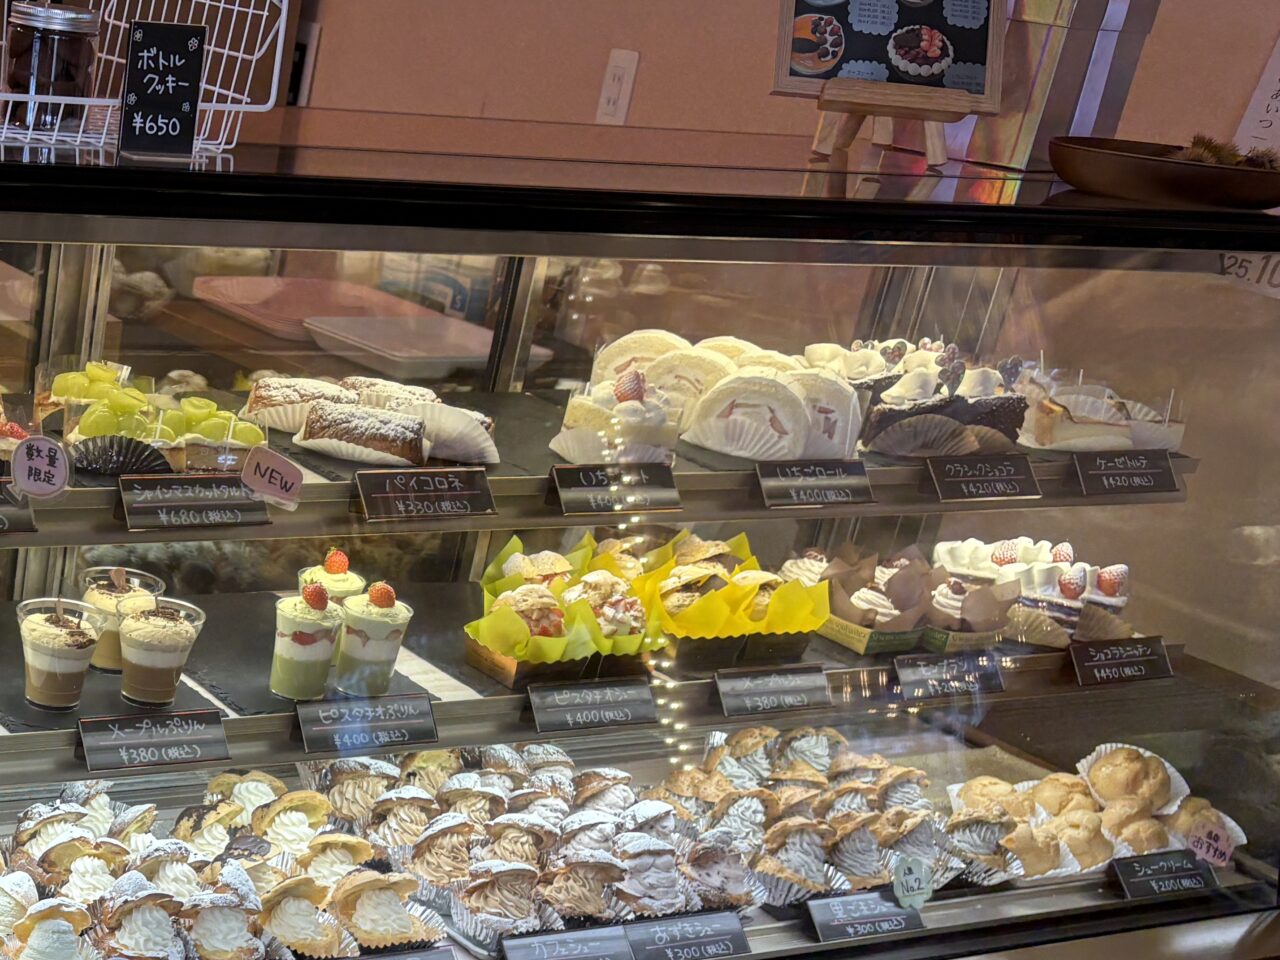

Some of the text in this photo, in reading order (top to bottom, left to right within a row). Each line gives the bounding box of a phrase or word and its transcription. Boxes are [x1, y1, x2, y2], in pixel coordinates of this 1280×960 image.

[137, 47, 186, 71] ボトル
[143, 73, 190, 95] クッキー
[131, 111, 181, 137] ¥650
[25, 442, 60, 468] 数量
[26, 466, 56, 487] 限定
[253, 461, 296, 494] NEW
